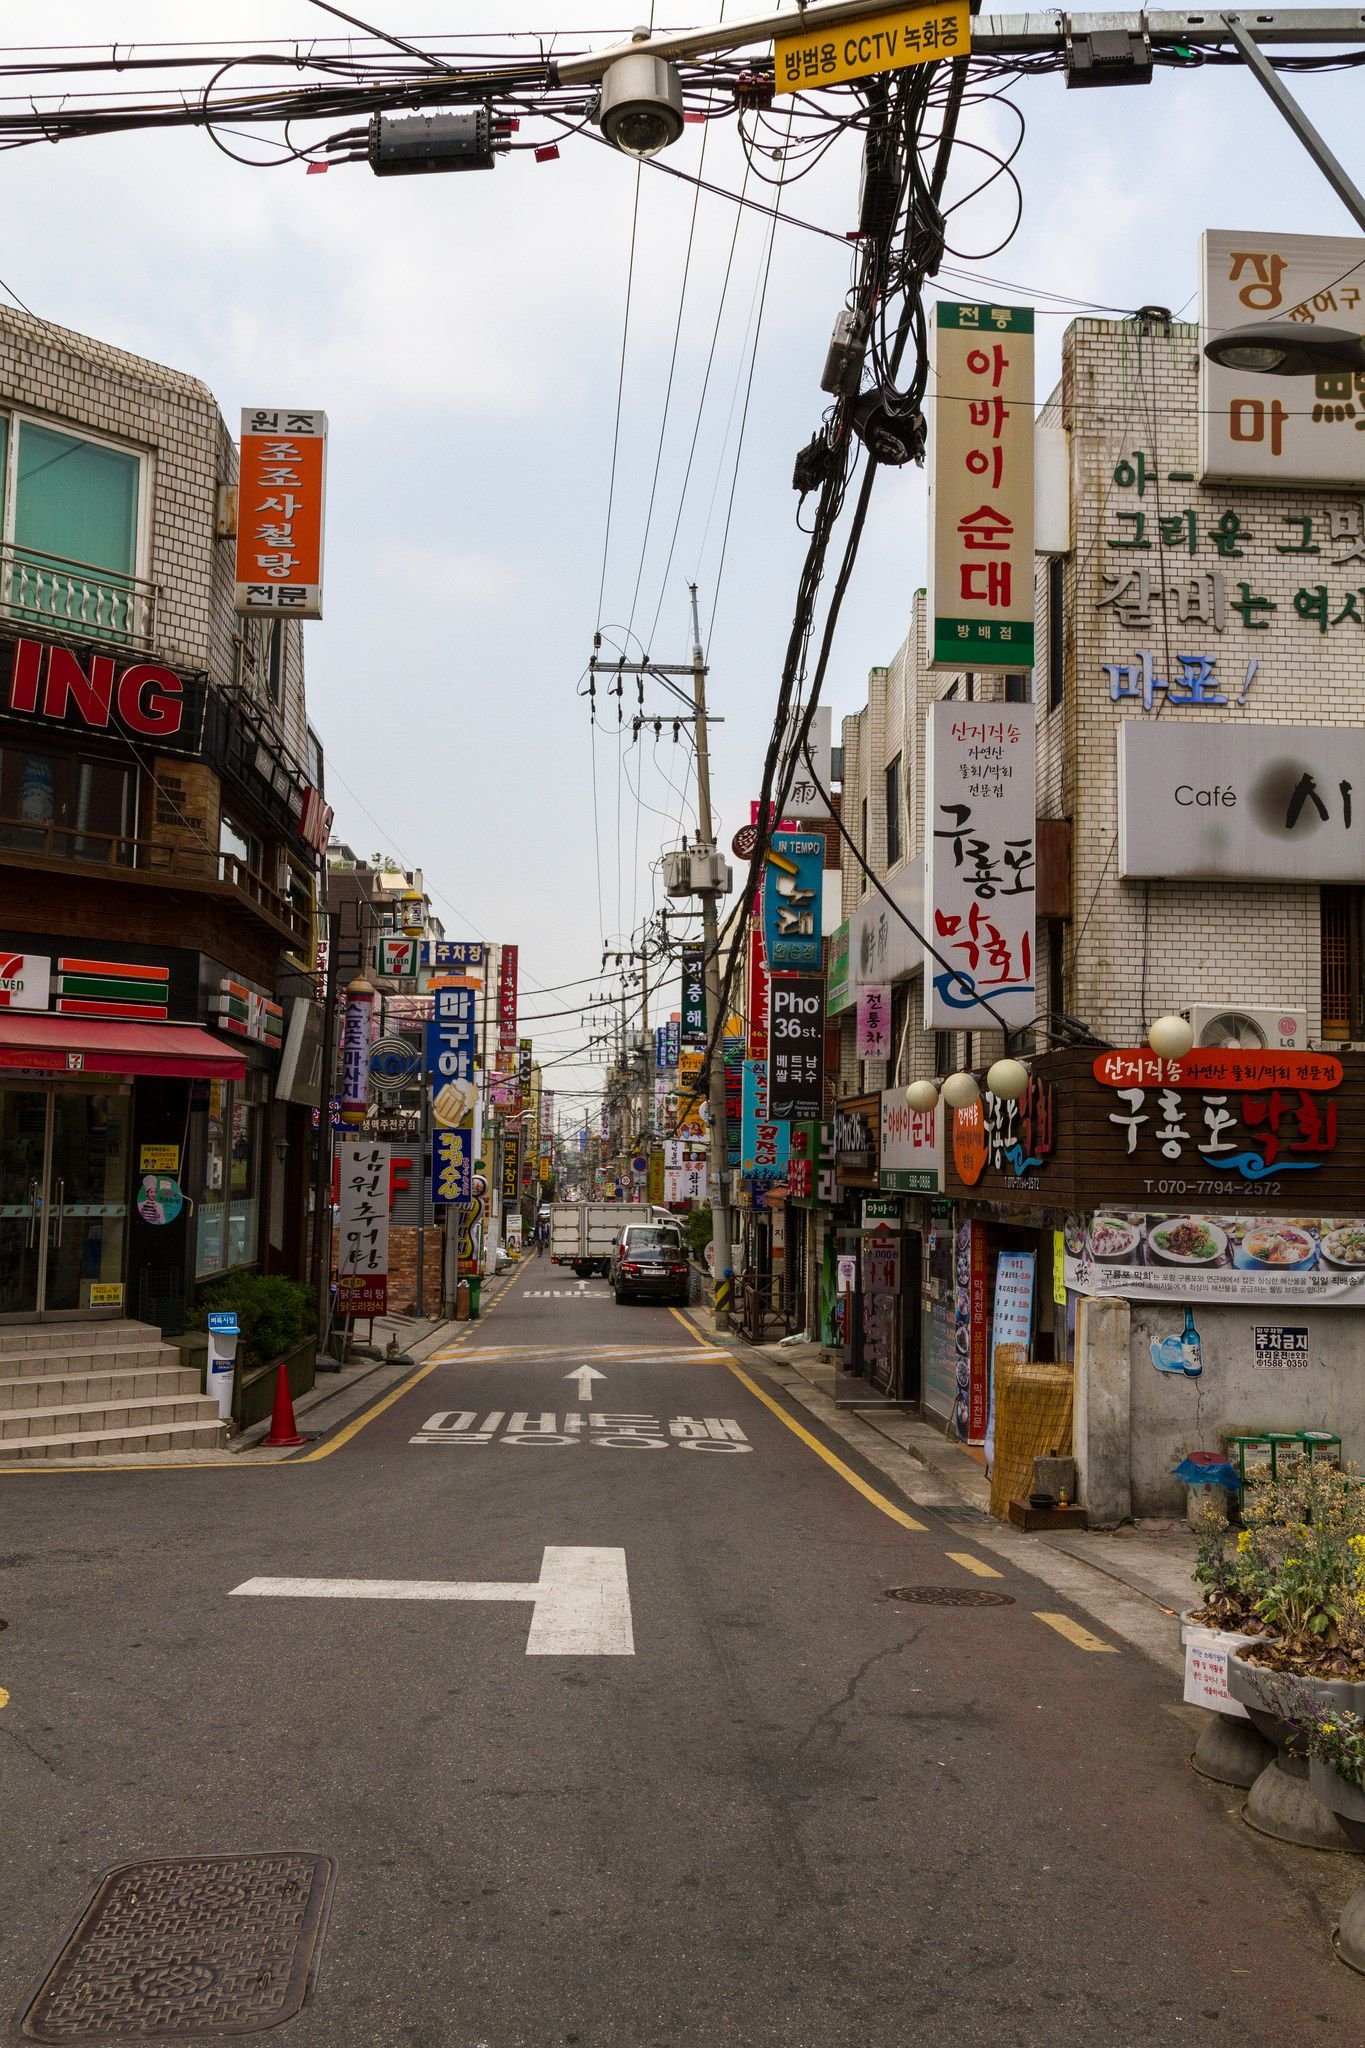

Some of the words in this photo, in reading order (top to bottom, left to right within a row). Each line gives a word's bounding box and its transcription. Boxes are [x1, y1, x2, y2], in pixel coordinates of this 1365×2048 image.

[785, 43, 837, 81] 방범용
[844, 29, 898, 66] CCTV
[904, 16, 958, 52] 녹화중
[958, 307, 1012, 329] 전통
[251, 411, 314, 434] 원조
[254, 442, 304, 578] 조조사철탕
[1107, 509, 1253, 557] 그리운
[246, 585, 308, 608] 전문
[1095, 567, 1277, 632] 갈비는
[957, 624, 1012, 641] 방배점
[10, 638, 184, 736] ING
[951, 721, 1021, 744] 산지직송
[967, 746, 1004, 761] 자연산
[958, 763, 1013, 780] 물회/막회
[967, 782, 1004, 798] 전문점
[1174, 785, 1238, 807] Café
[790, 841, 821, 855] TEMPO
[933, 804, 1035, 899] 구룡포
[436, 944, 482, 962] 주차장
[934, 901, 1031, 984] 막회
[396, 1000, 436, 1021] 주차
[866, 993, 884, 1044] 전통차
[774, 1017, 801, 1039] 36
[1280, 1038, 1295, 1048] LG
[776, 1054, 818, 1068] 베트남
[1104, 1057, 1183, 1083] 산지직송
[1187, 1066, 1228, 1081] 자연산
[1231, 1065, 1291, 1083] 물회/막회
[1296, 1066, 1337, 1082] 전문점
[775, 1069, 818, 1083] 쌀국수
[1108, 1087, 1237, 1159] 구룡포
[1242, 1090, 1337, 1166] 막회
[503, 1141, 517, 1195] 맥주창고
[1143, 1180, 1281, 1196] T.070-7794-2572
[347, 1150, 386, 1269] 남원추어탕
[867, 1203, 898, 1216] 아바이
[1256, 1334, 1308, 1350] 주차금지
[1263, 1360, 1308, 1368] 1588-0350
[408, 1411, 753, 1452] 일방통행
